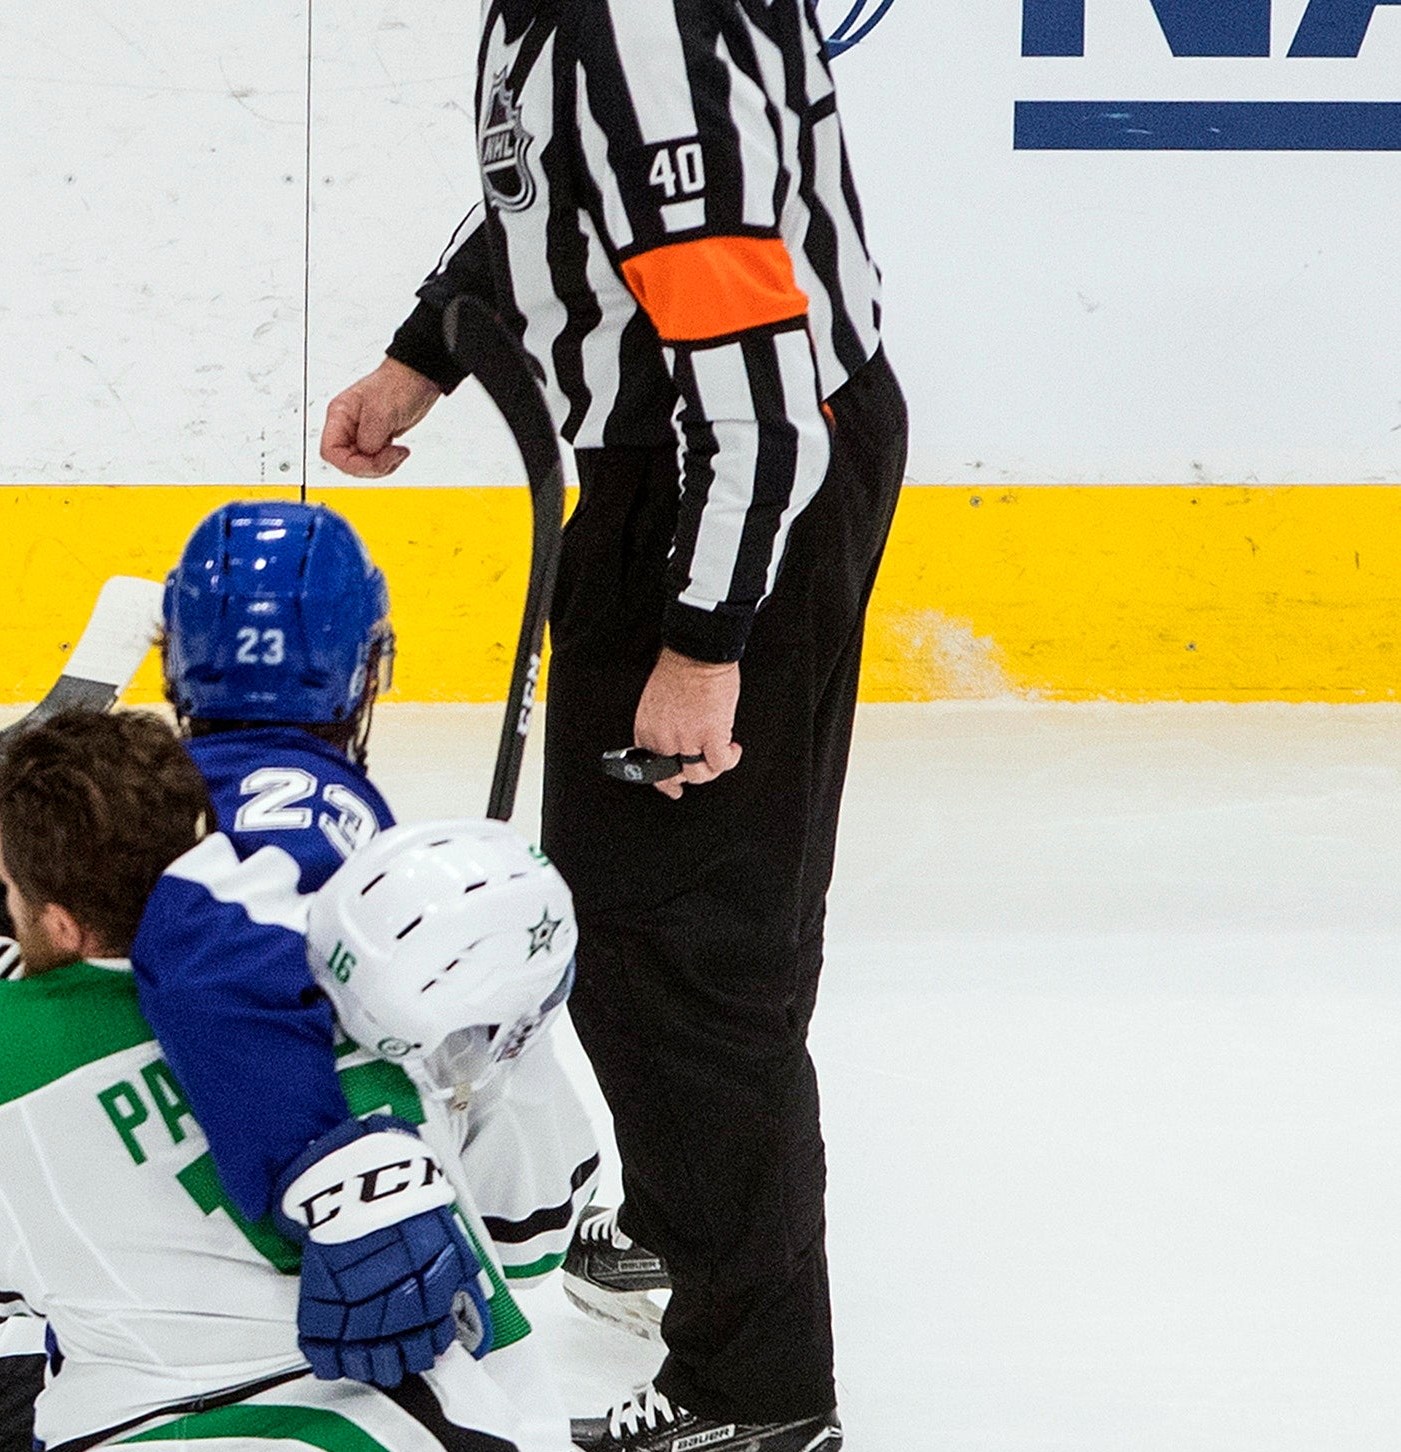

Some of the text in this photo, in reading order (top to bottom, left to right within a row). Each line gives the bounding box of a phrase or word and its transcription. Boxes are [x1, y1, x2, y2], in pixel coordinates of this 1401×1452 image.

[648, 143, 704, 197] 40
[235, 627, 287, 668] 23
[326, 938, 357, 987] 16
[96, 1057, 197, 1167] PA
[677, 1427, 732, 1451] BAUER
